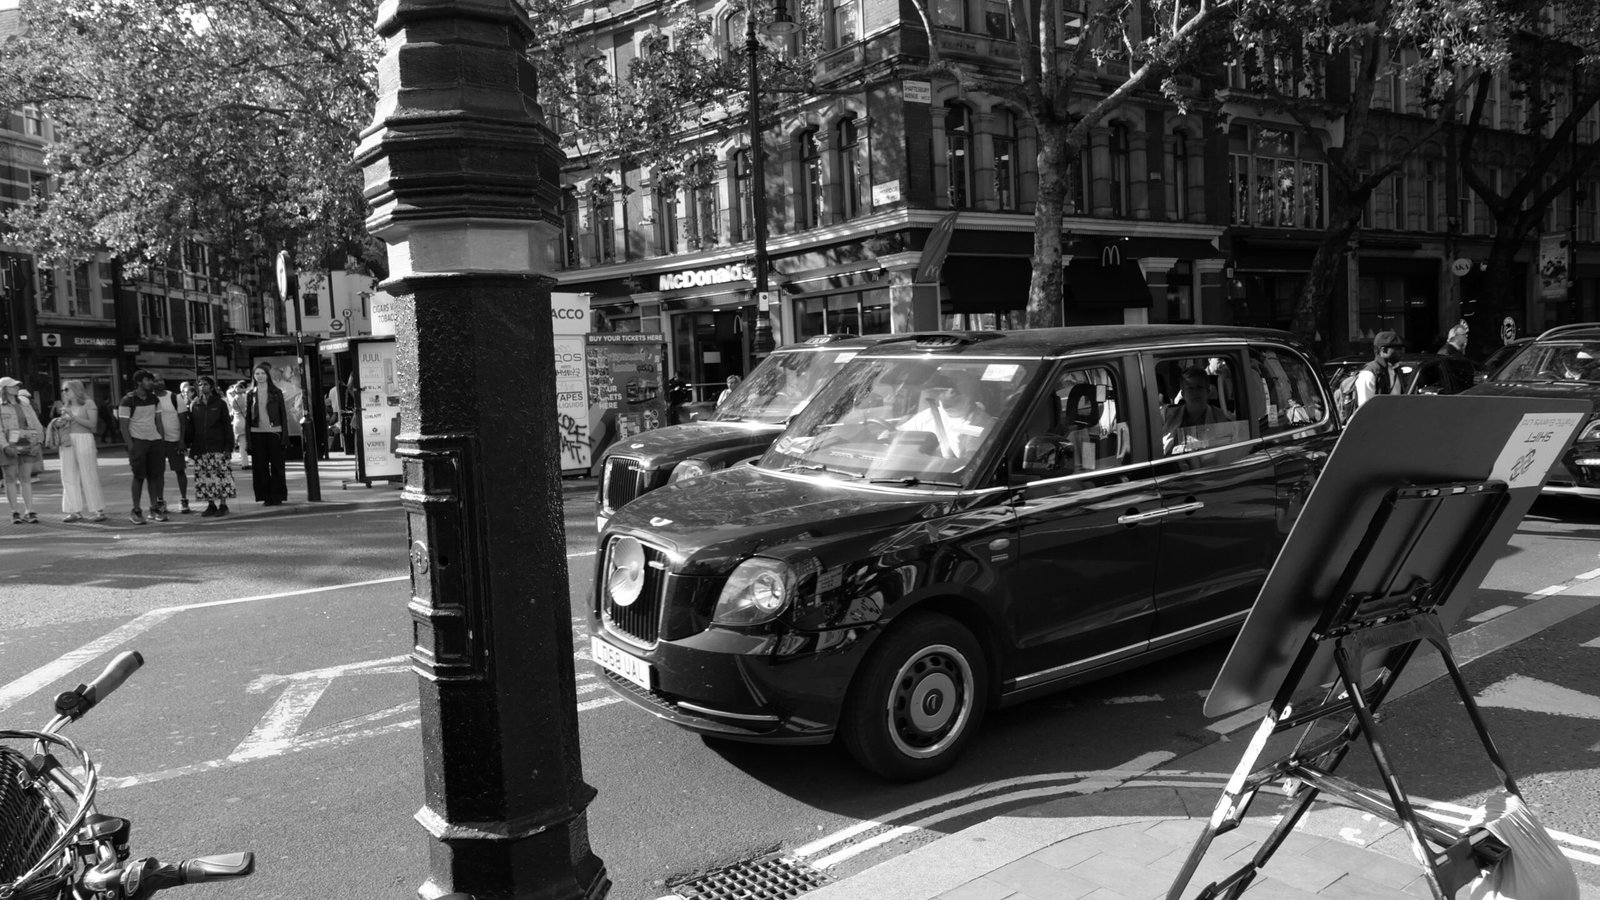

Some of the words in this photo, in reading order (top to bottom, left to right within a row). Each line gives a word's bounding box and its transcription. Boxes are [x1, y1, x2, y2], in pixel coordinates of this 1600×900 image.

[659, 263, 754, 291] McDonald's
[74, 337, 117, 346] EXCHANGE
[624, 655, 645, 683] UAL
